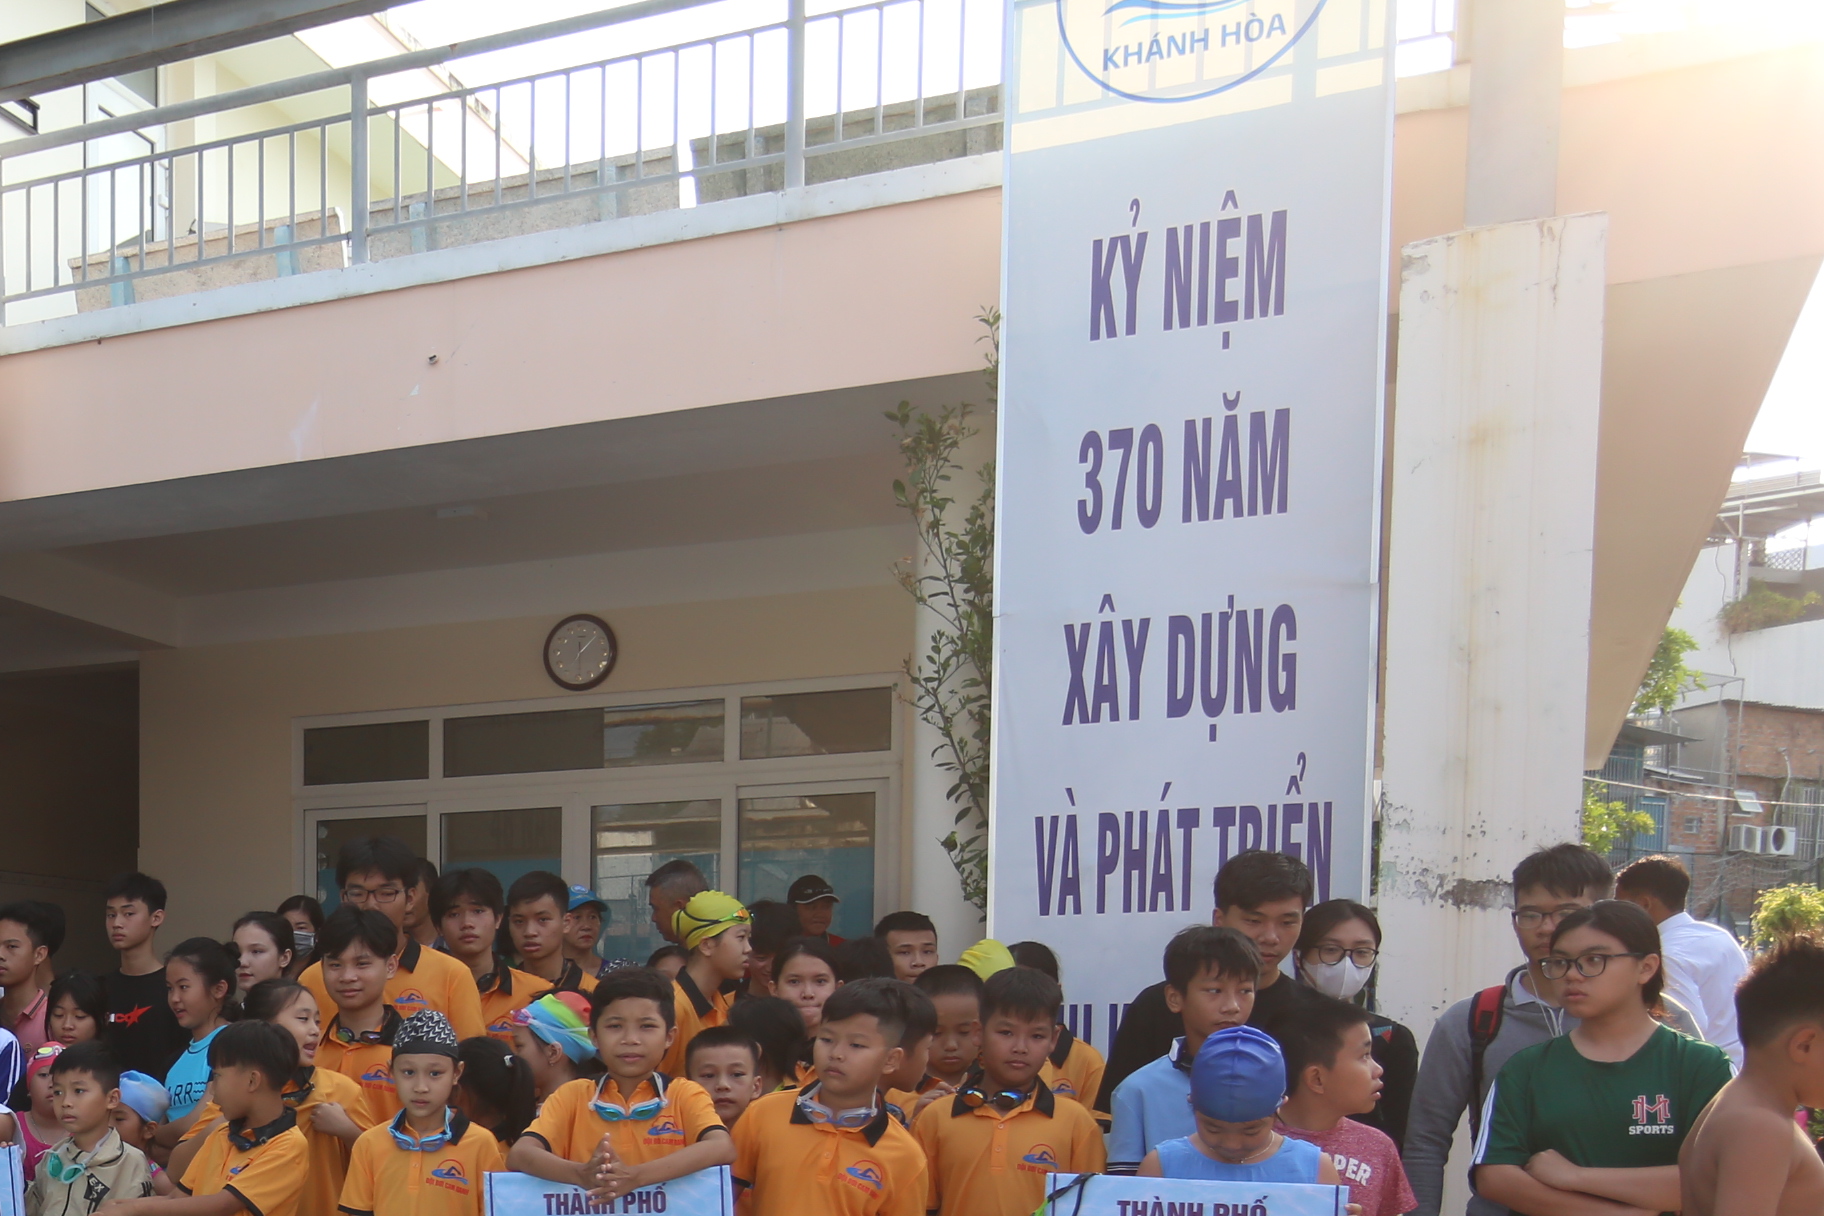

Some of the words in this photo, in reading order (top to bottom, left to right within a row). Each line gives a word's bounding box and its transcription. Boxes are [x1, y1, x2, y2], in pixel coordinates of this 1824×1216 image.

[1102, 28, 1209, 72] KHÁNH
[1220, 12, 1287, 47] HÒA
[1090, 198, 1149, 342] KỶ
[1163, 189, 1288, 350] NIỆM
[1077, 423, 1164, 535] 370
[1181, 390, 1291, 524] NĂM
[1061, 593, 1151, 726] XÂY
[1166, 594, 1297, 743] DỰNG
[1034, 787, 1082, 917] VÀ
[1096, 781, 1201, 914] PHÁT
[623, 1182, 667, 1214] PHỐ
[1628, 1125, 1674, 1135] SPORTS
